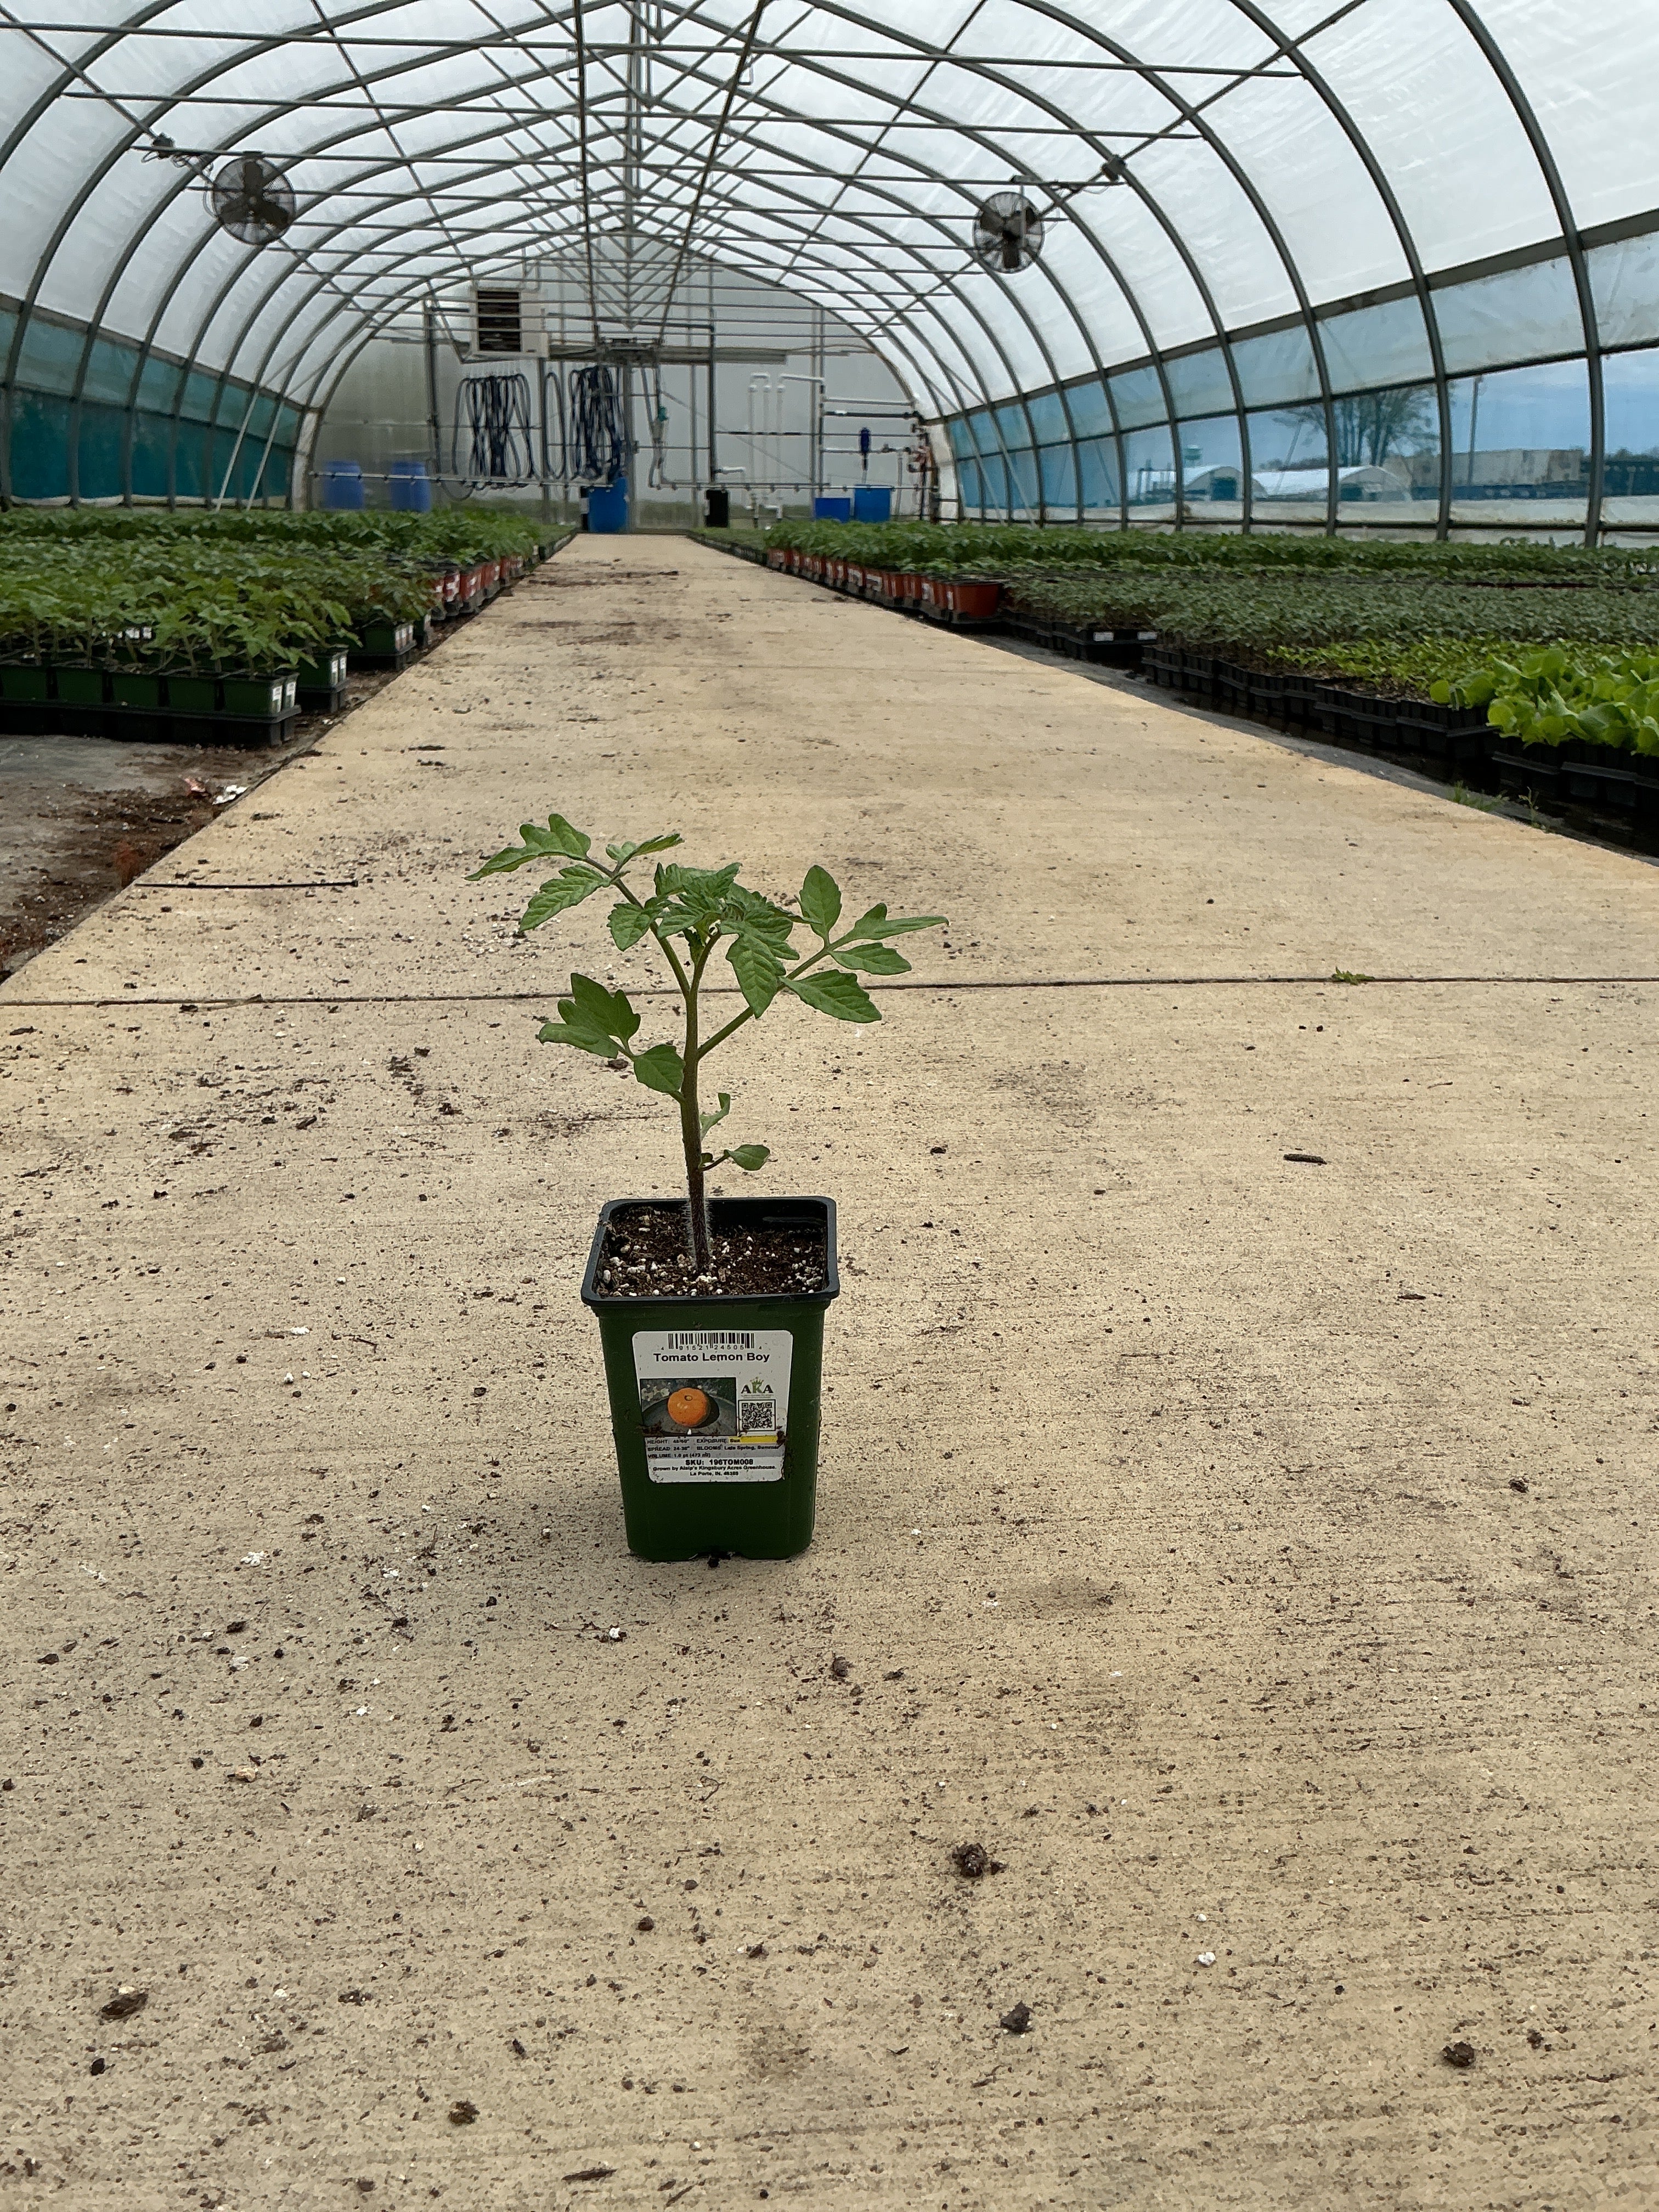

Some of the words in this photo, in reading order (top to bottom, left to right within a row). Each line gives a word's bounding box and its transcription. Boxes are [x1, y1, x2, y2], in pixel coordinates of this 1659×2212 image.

[653, 1353, 699, 1362] Tomato
[702, 1352, 743, 1362] Lemon
[747, 1352, 770, 1363] Boy
[741, 1380, 774, 1393] AKA
